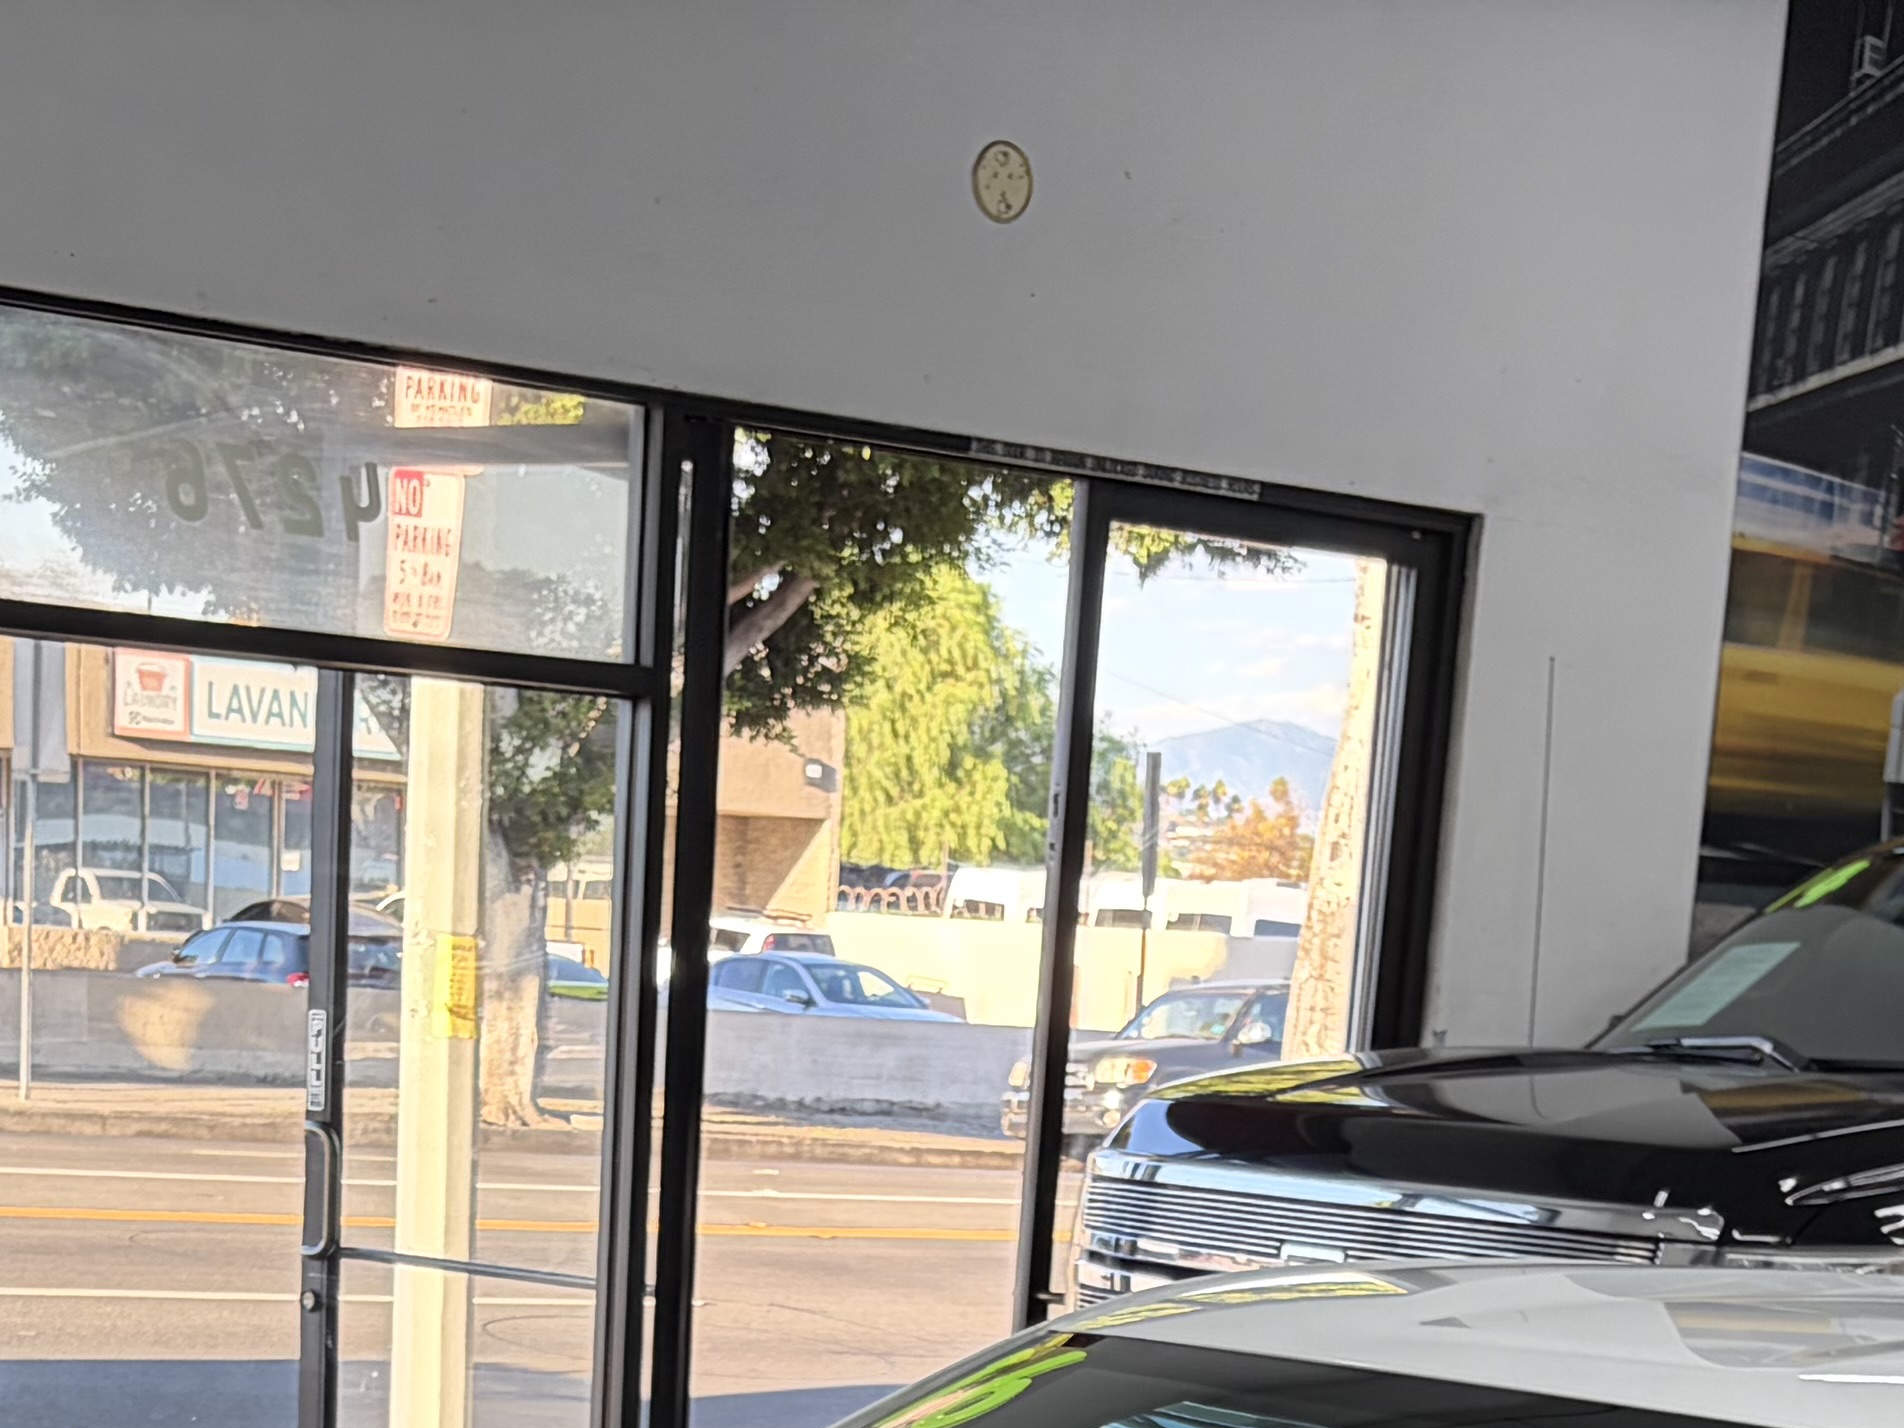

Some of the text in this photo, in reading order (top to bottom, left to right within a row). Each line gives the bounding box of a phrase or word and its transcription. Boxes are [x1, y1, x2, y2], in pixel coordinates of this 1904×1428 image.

[405, 375, 480, 404] PARKING
[394, 477, 423, 515] NO
[394, 523, 452, 558] PARKING
[207, 680, 309, 729] LAVAN
